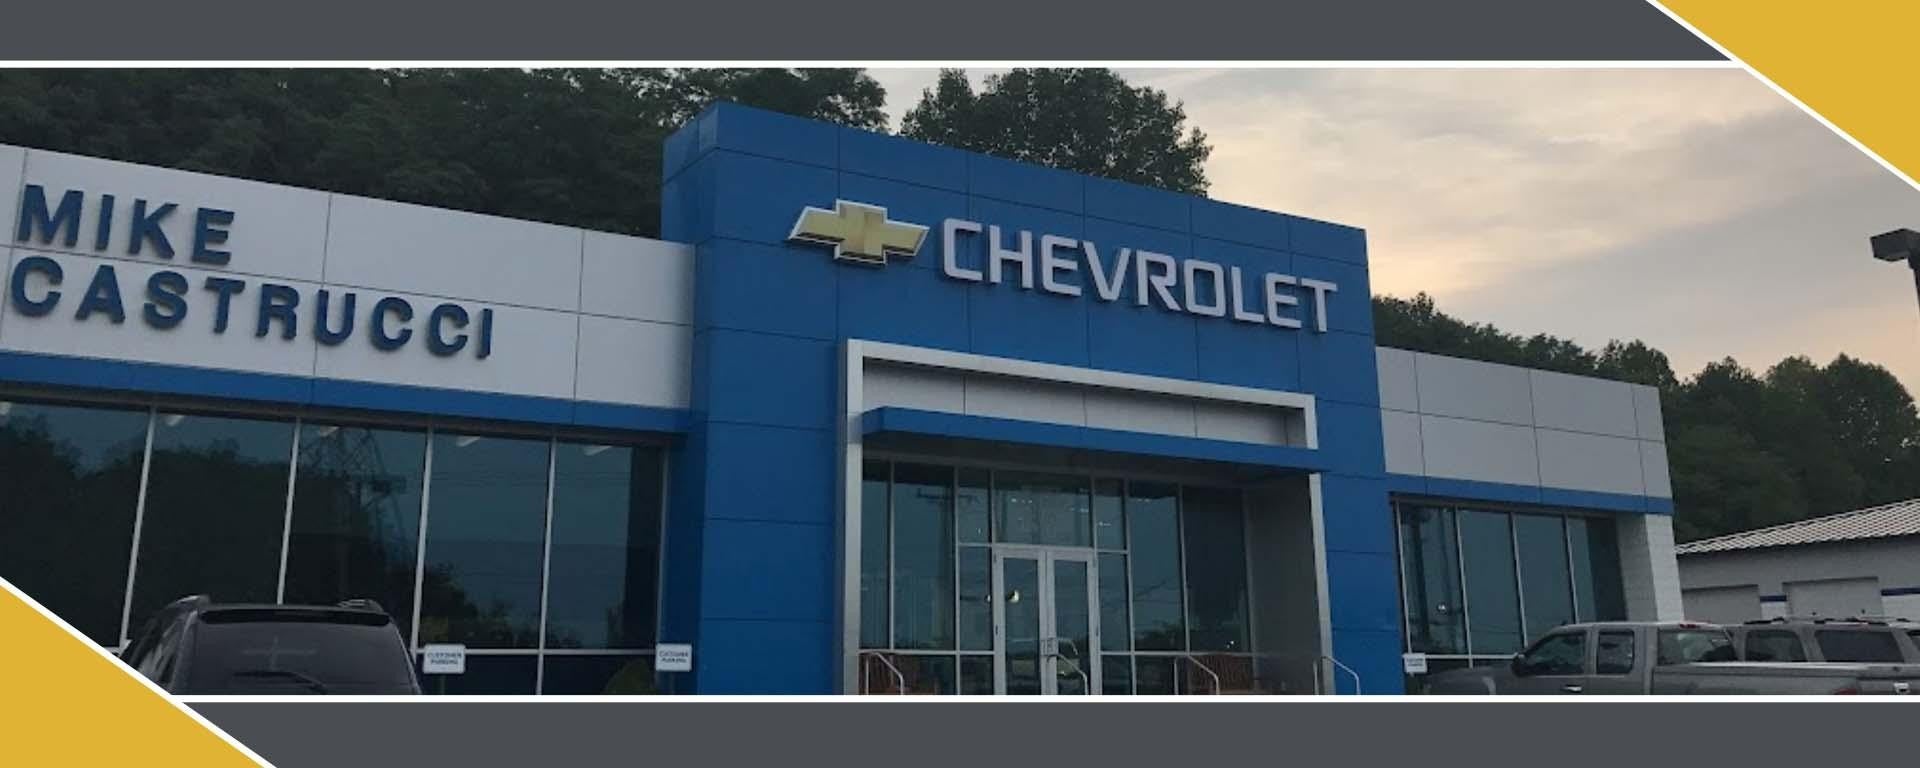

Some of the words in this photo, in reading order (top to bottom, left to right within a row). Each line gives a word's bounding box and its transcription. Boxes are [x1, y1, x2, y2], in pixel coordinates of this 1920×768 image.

[17, 184, 236, 266] MIKE
[941, 217, 1338, 334] CHEVROLET
[10, 255, 494, 360] CASTRUCCI
